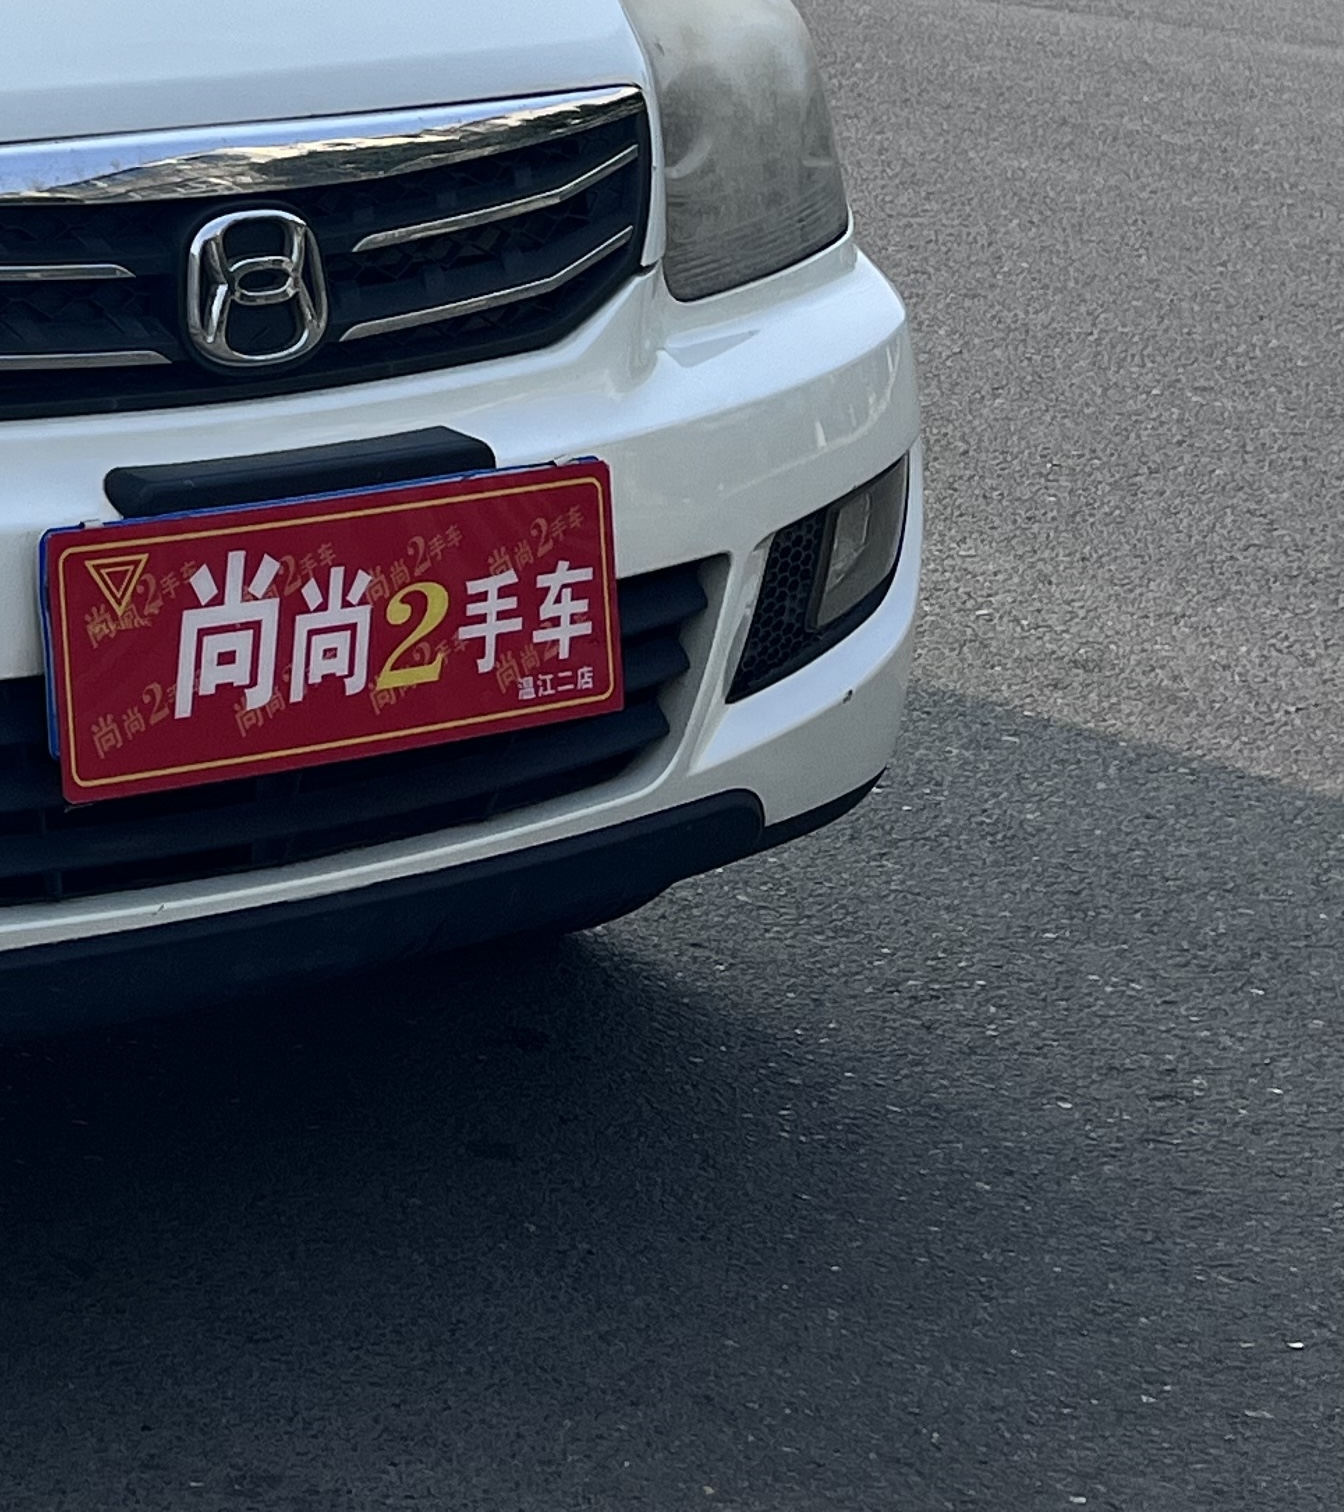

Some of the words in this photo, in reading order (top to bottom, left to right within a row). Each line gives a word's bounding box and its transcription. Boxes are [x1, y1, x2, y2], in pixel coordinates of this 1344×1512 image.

[174, 549, 595, 719] 尚尚2手车
[517, 666, 594, 700] 温江二店
